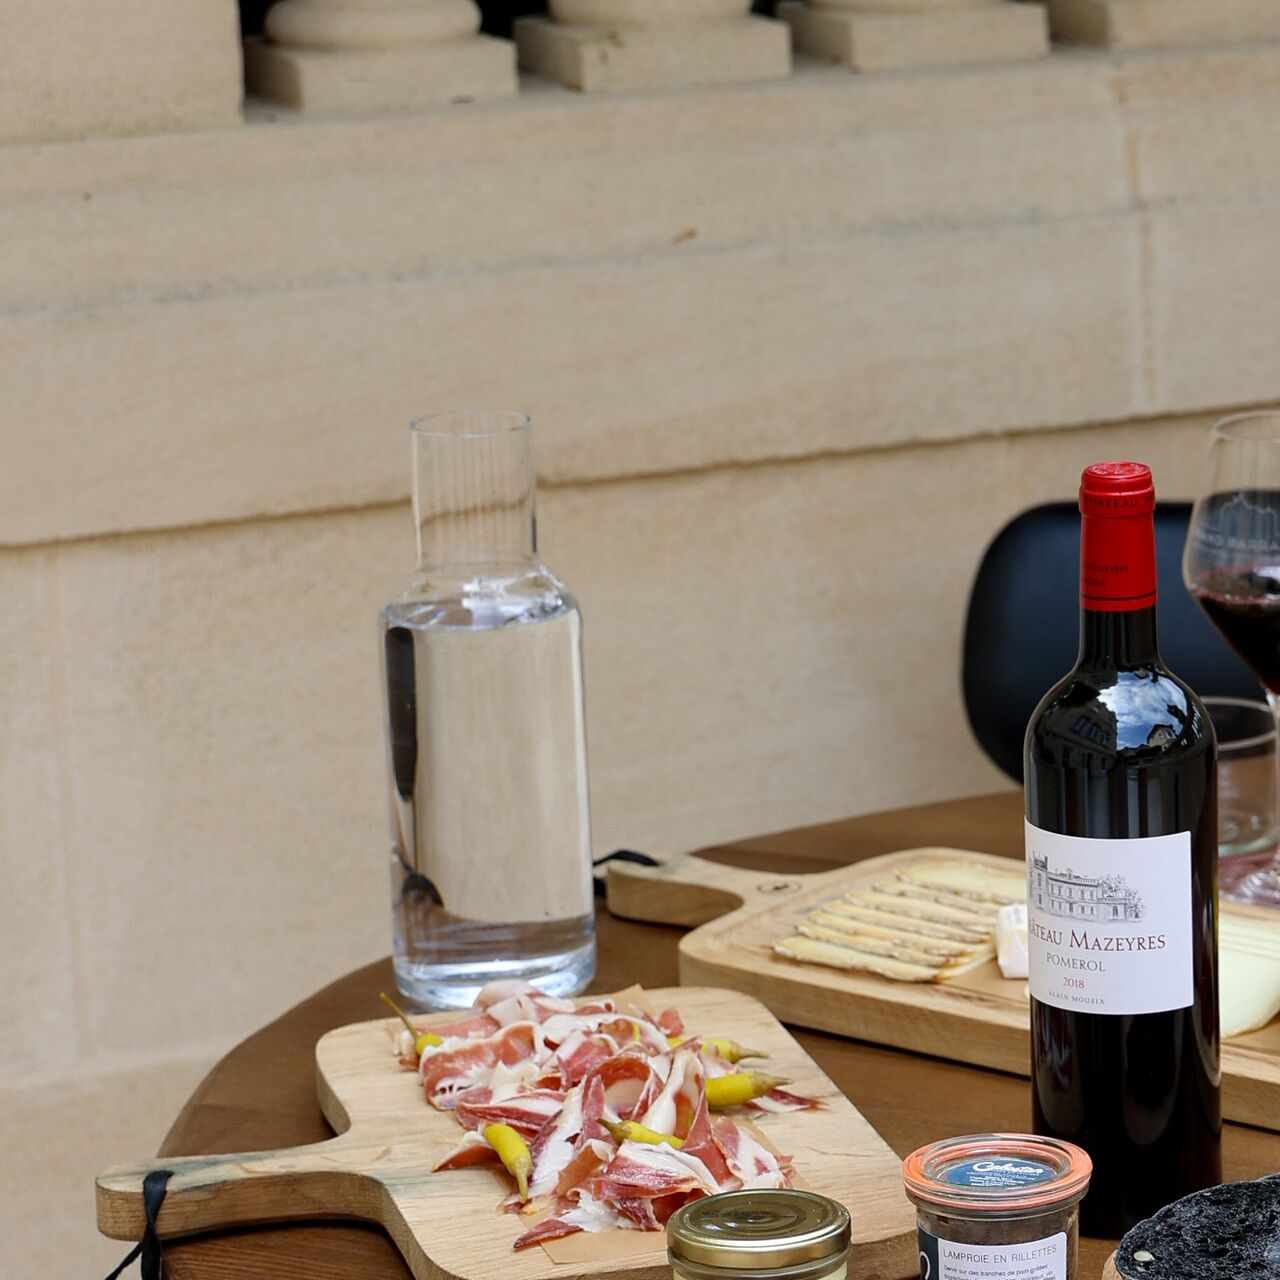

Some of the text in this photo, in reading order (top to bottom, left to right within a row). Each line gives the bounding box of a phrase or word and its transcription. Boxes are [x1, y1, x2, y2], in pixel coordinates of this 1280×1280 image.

[1070, 929, 1166, 952] MAZEYRES
[1046, 952, 1106, 972] POMEROL
[1063, 977, 1085, 989] 2018
[1049, 991, 1069, 1001] ALAIN
[943, 1244, 1056, 1263] LAMPROIE EN RILLETTES
